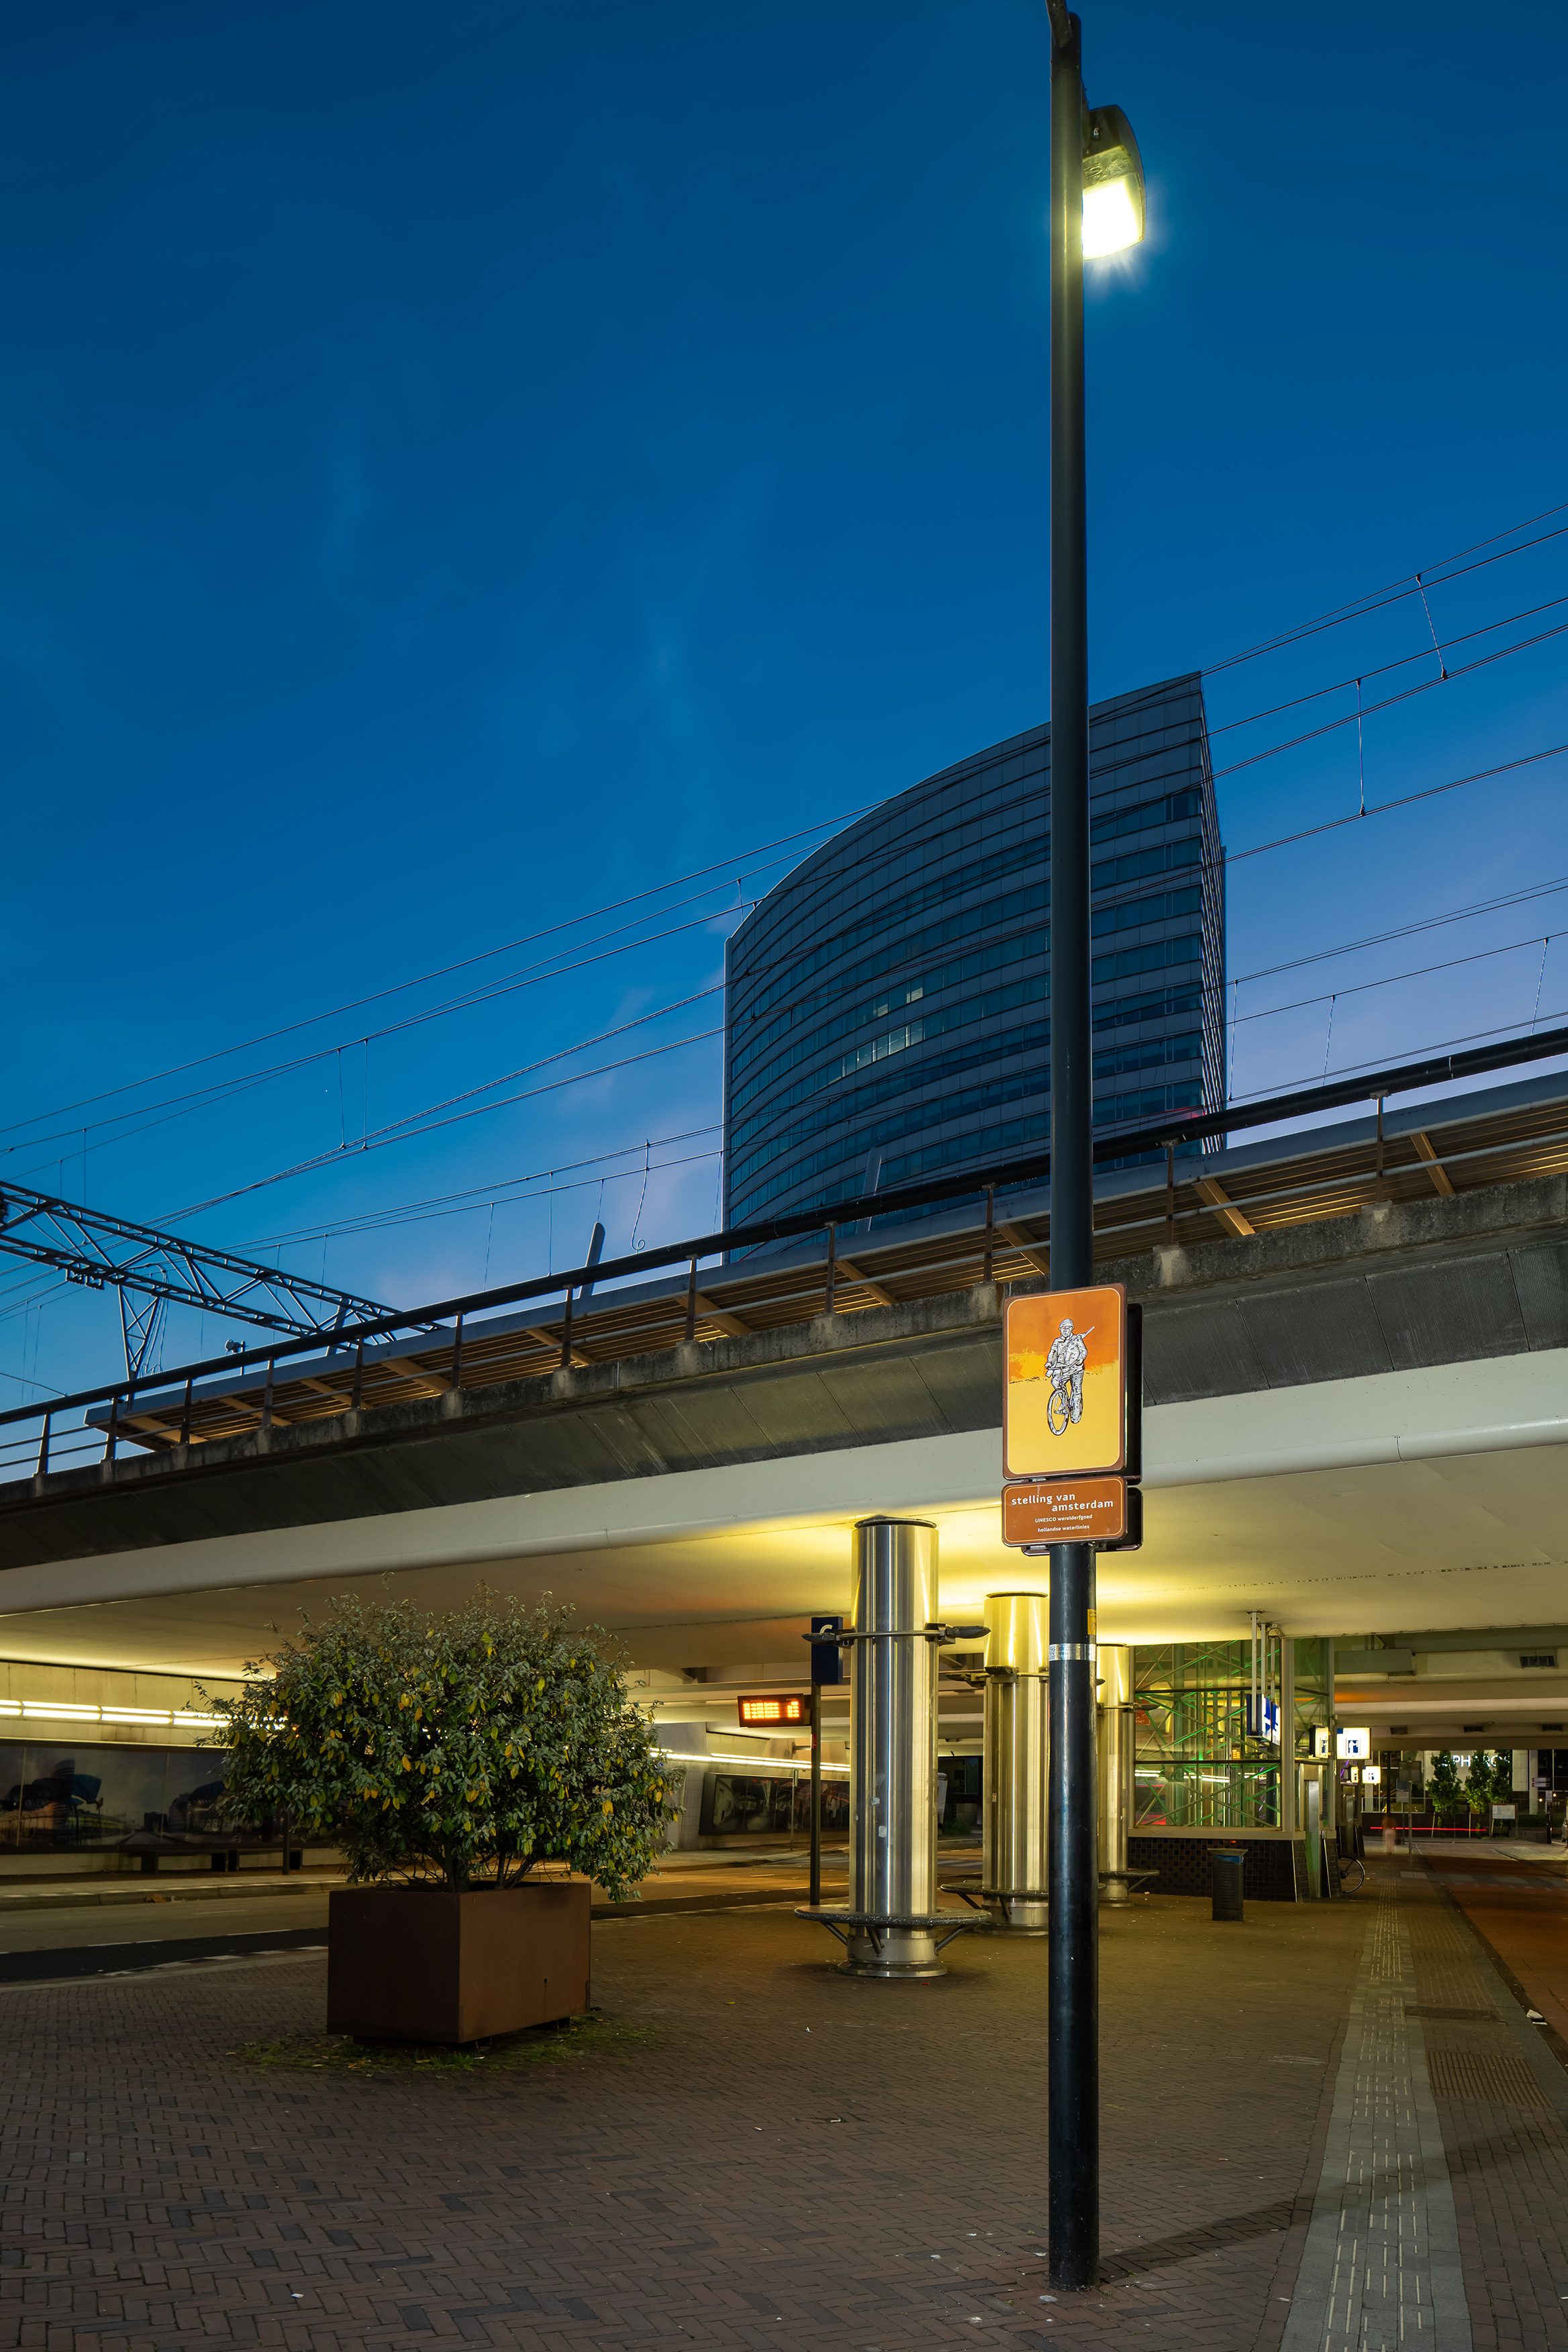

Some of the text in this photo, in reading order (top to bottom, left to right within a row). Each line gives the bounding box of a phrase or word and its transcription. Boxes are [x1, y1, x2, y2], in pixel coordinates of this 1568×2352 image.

[1012, 1493, 1075, 1506] stelling van
[1051, 1500, 1114, 1512] amsterdam
